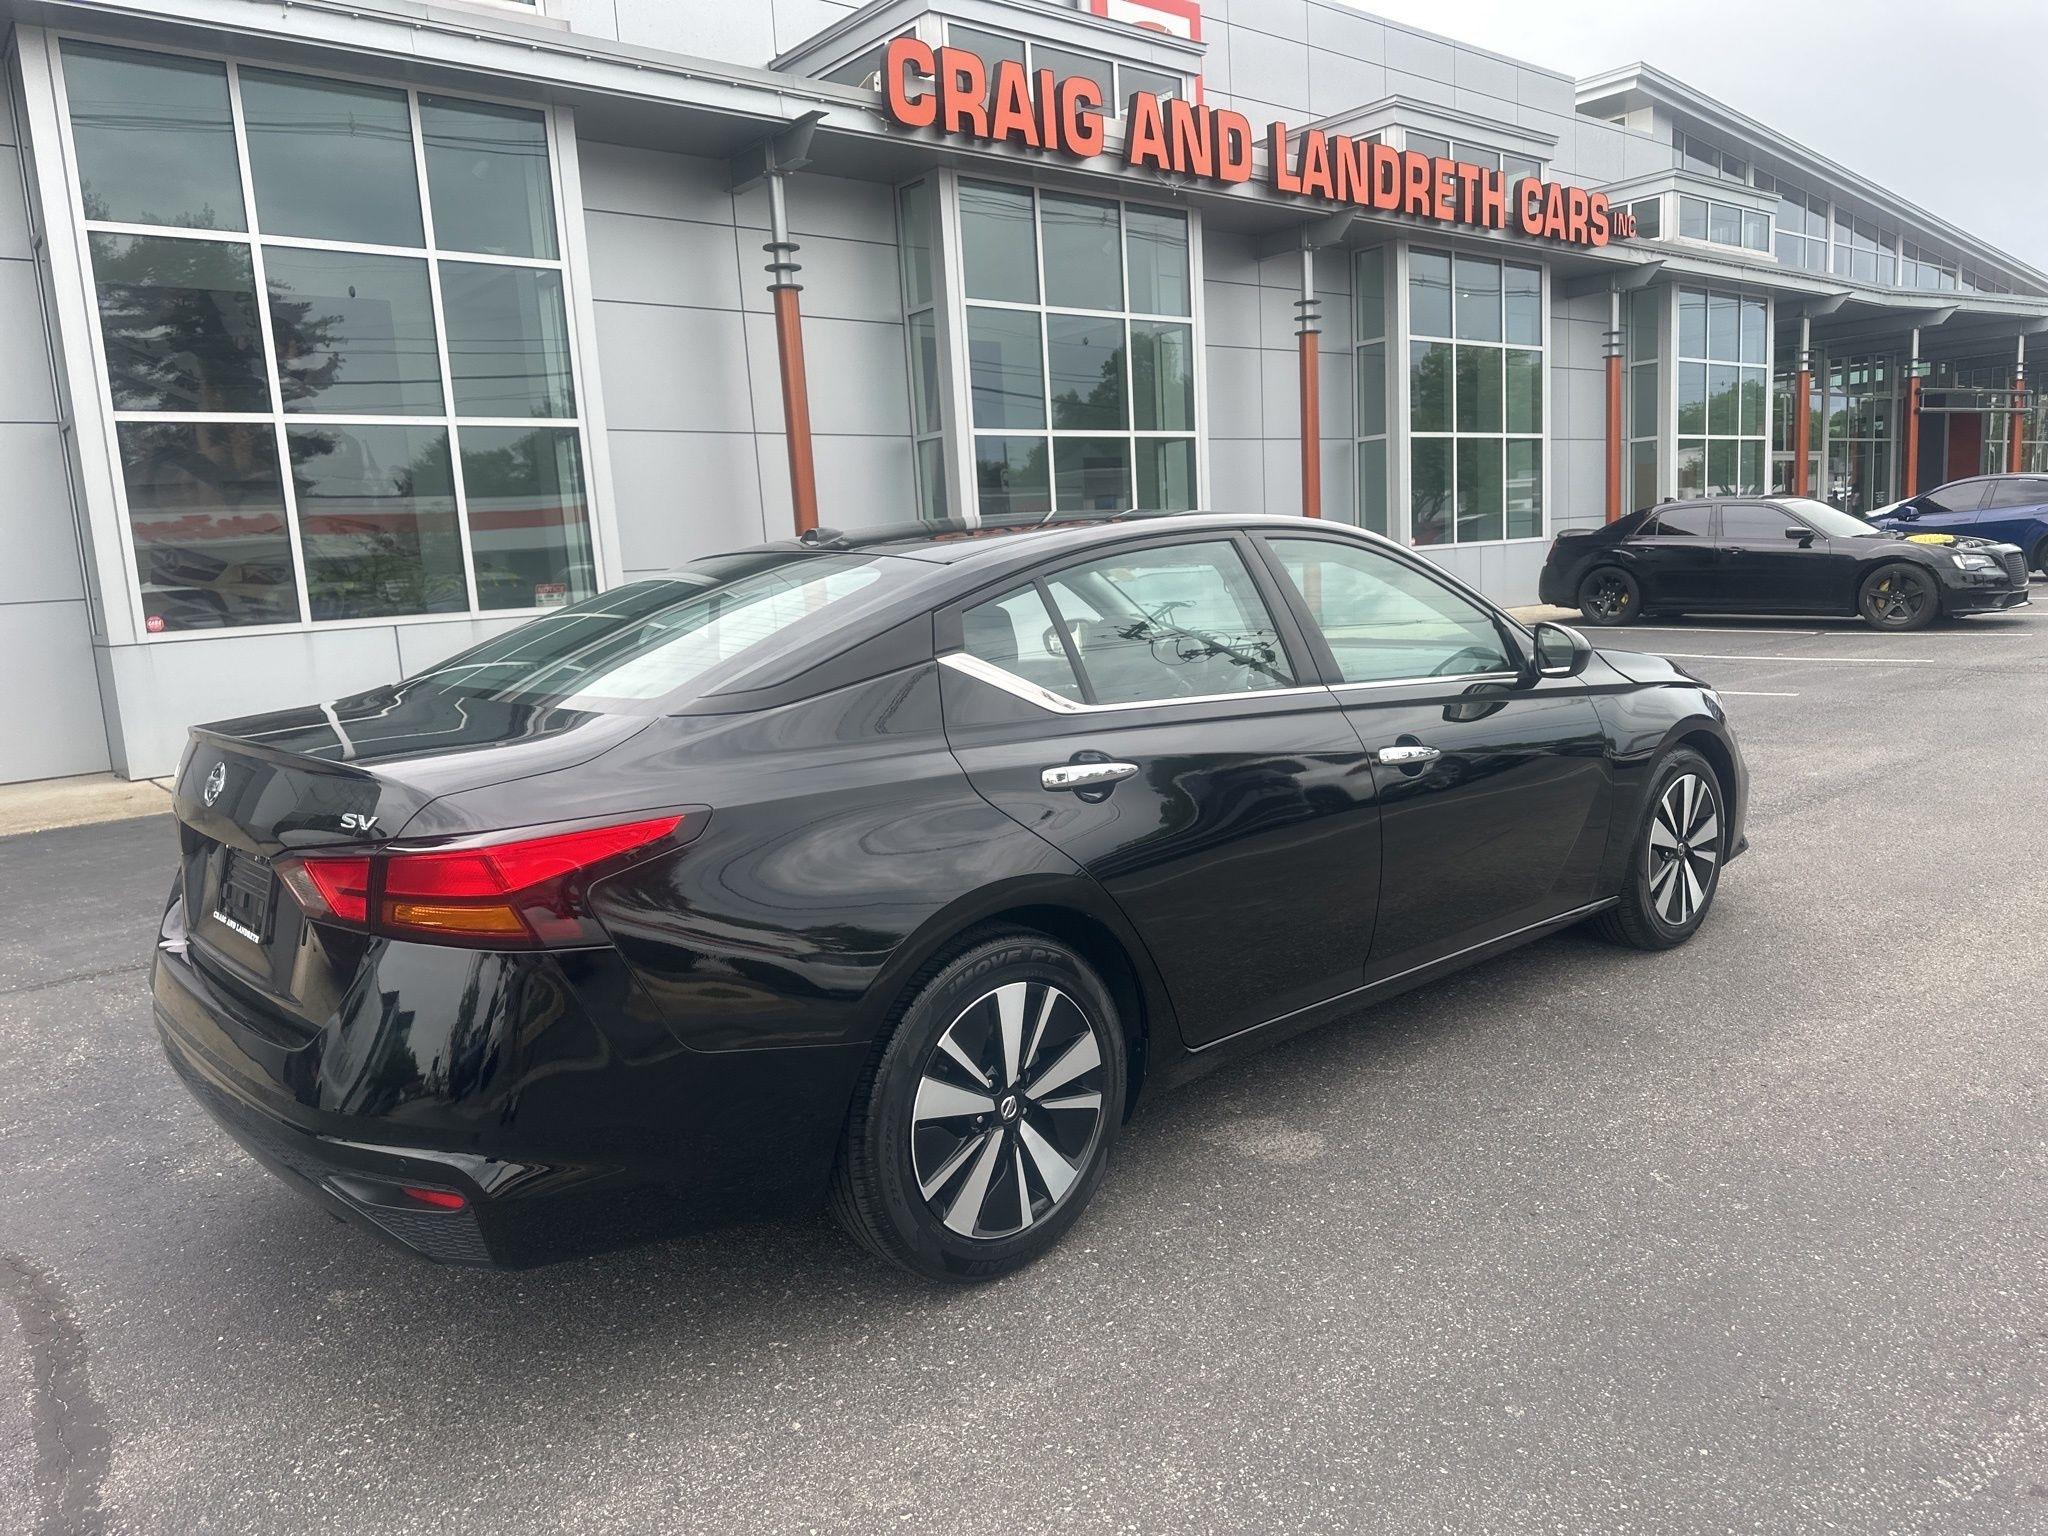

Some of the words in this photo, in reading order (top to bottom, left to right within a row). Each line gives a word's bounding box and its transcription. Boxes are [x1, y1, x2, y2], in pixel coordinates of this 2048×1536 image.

[882, 36, 1104, 158] CRAIG
[1125, 91, 1252, 183] AND
[1267, 121, 1505, 229] LANDRETH
[1516, 176, 1610, 248] CARS
[1613, 211, 1638, 238] INC
[340, 813, 379, 831] SV
